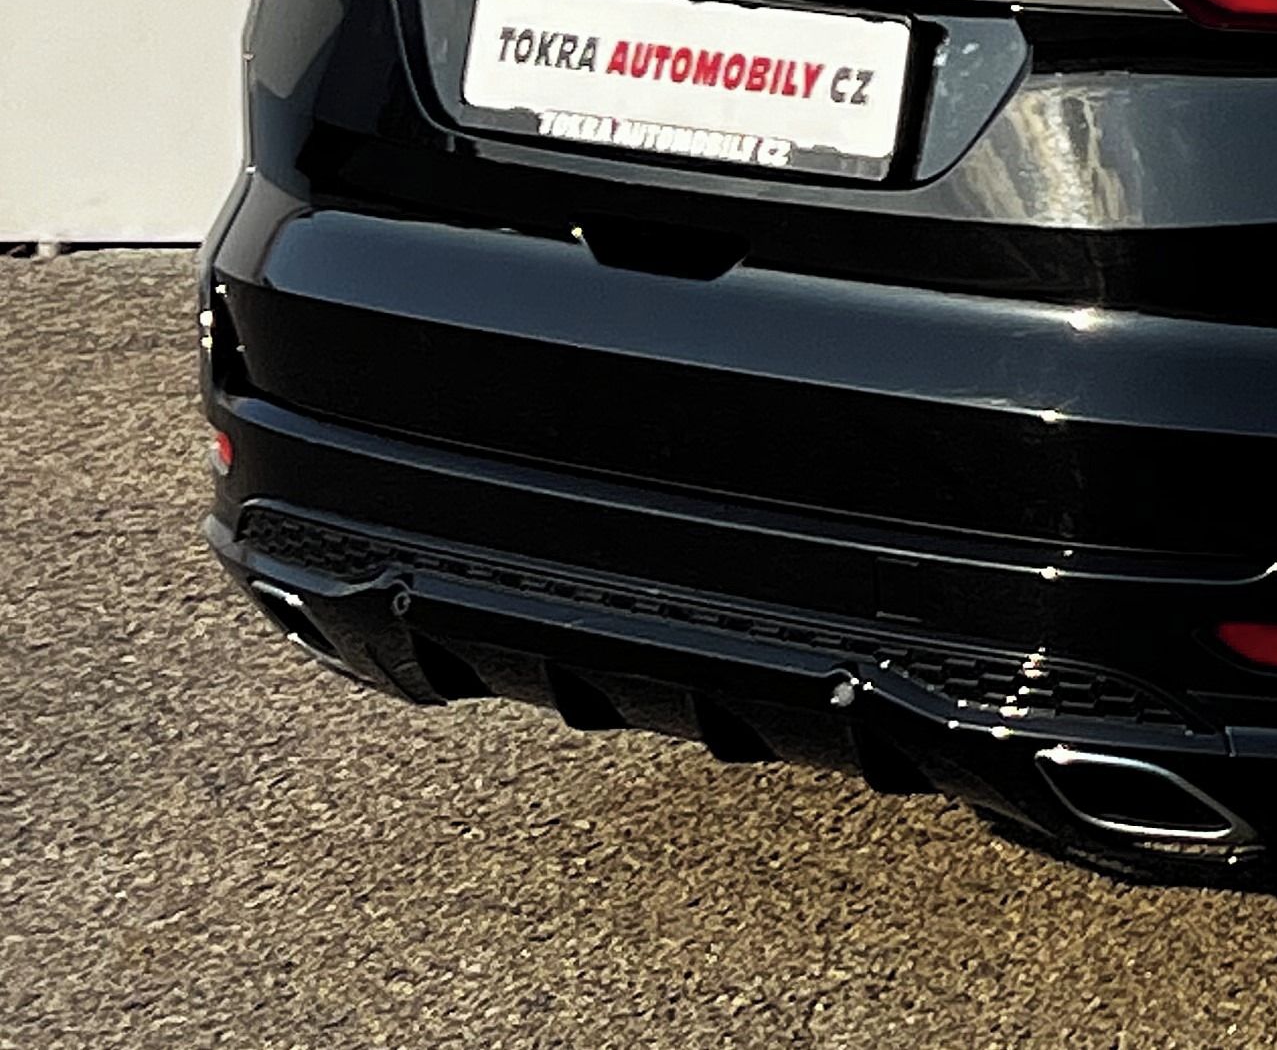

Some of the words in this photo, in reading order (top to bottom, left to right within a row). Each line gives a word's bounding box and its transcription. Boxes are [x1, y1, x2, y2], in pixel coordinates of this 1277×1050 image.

[499, 26, 600, 72] TOKRA
[606, 41, 825, 99] AUTOMOBILY
[830, 66, 875, 105] CZ
